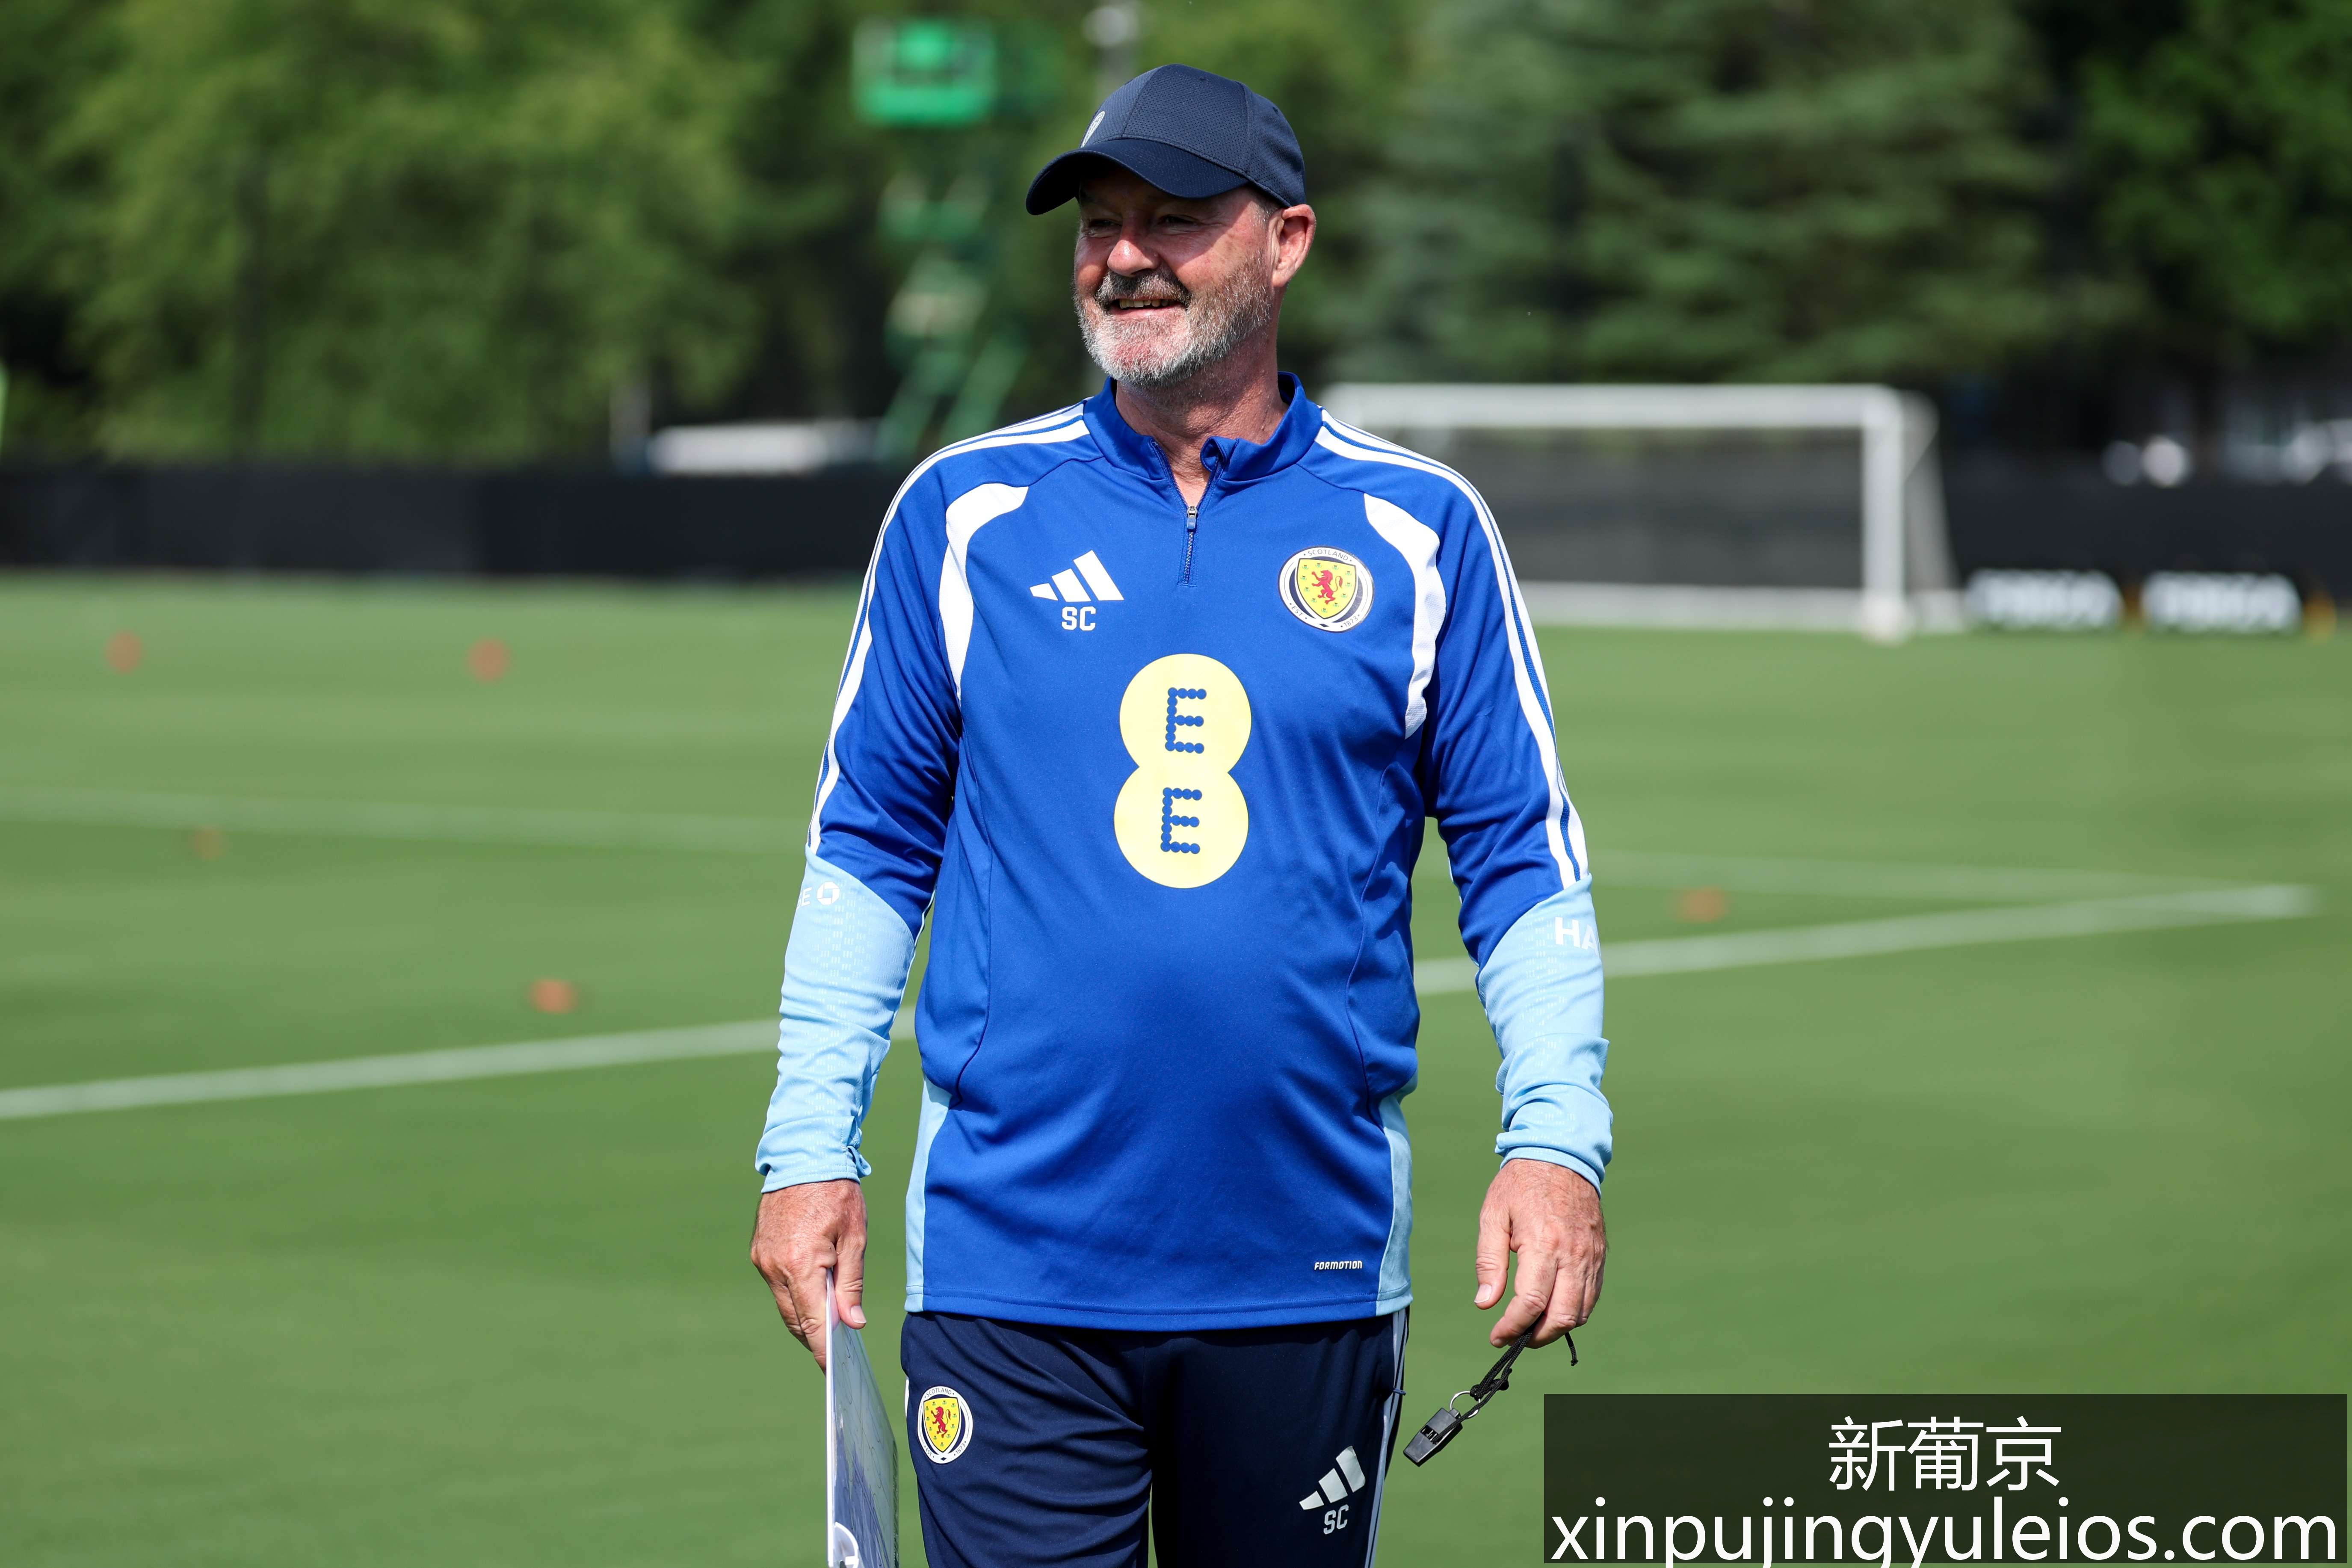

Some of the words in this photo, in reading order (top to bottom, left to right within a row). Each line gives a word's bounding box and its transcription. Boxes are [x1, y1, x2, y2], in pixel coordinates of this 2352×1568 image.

[1308, 549, 1348, 561] SCOTLAND
[1062, 606, 1096, 631] SC
[1291, 606, 1303, 616] EST
[1343, 616, 1358, 627] 1873
[926, 1388, 952, 1397] SCOTLAND
[956, 1443, 966, 1455] 1873
[1323, 1504, 1349, 1535] SC
